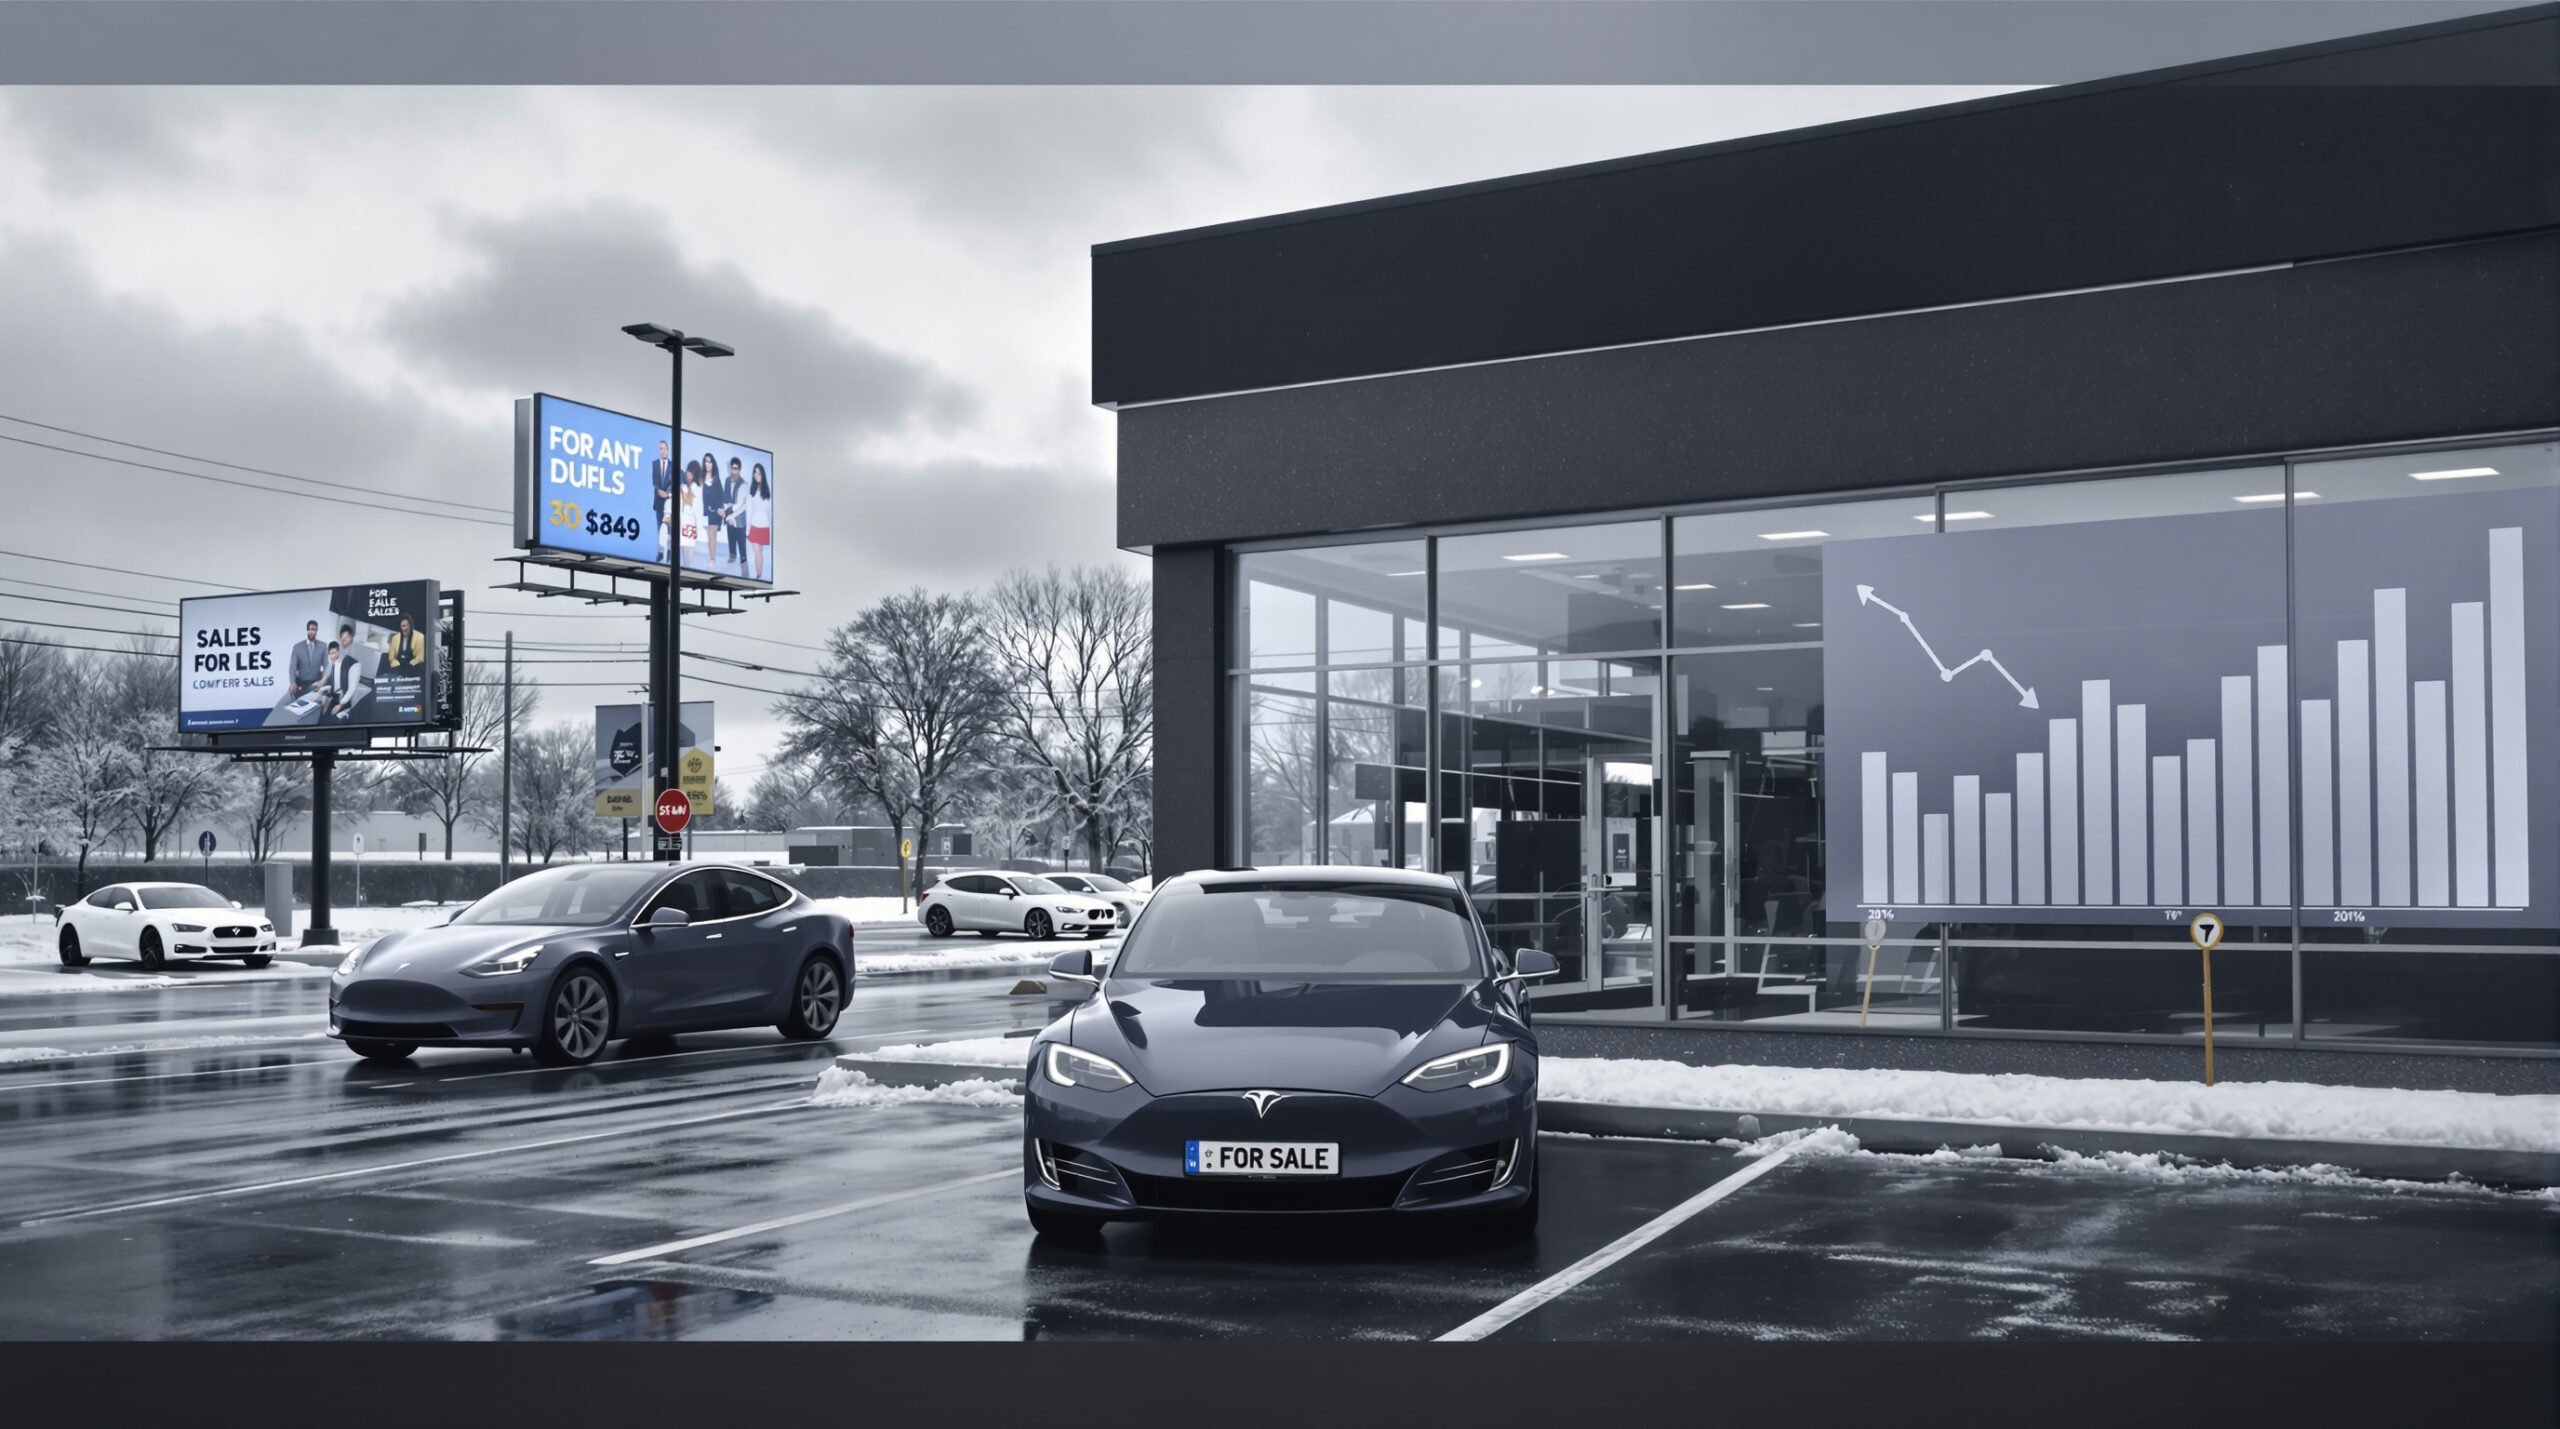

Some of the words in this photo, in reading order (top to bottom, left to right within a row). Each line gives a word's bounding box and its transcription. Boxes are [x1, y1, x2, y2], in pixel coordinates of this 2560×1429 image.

[550, 425, 594, 459] FOR
[598, 438, 643, 470] ANT
[549, 500, 581, 529] 30
[586, 509, 640, 541] $849
[197, 627, 261, 648] SALES
[195, 653, 230, 672] FOR
[236, 650, 272, 671] LES
[243, 676, 274, 687] SALES
[1220, 1147, 1263, 1168] FOR
[1270, 1148, 1329, 1169] SALE
